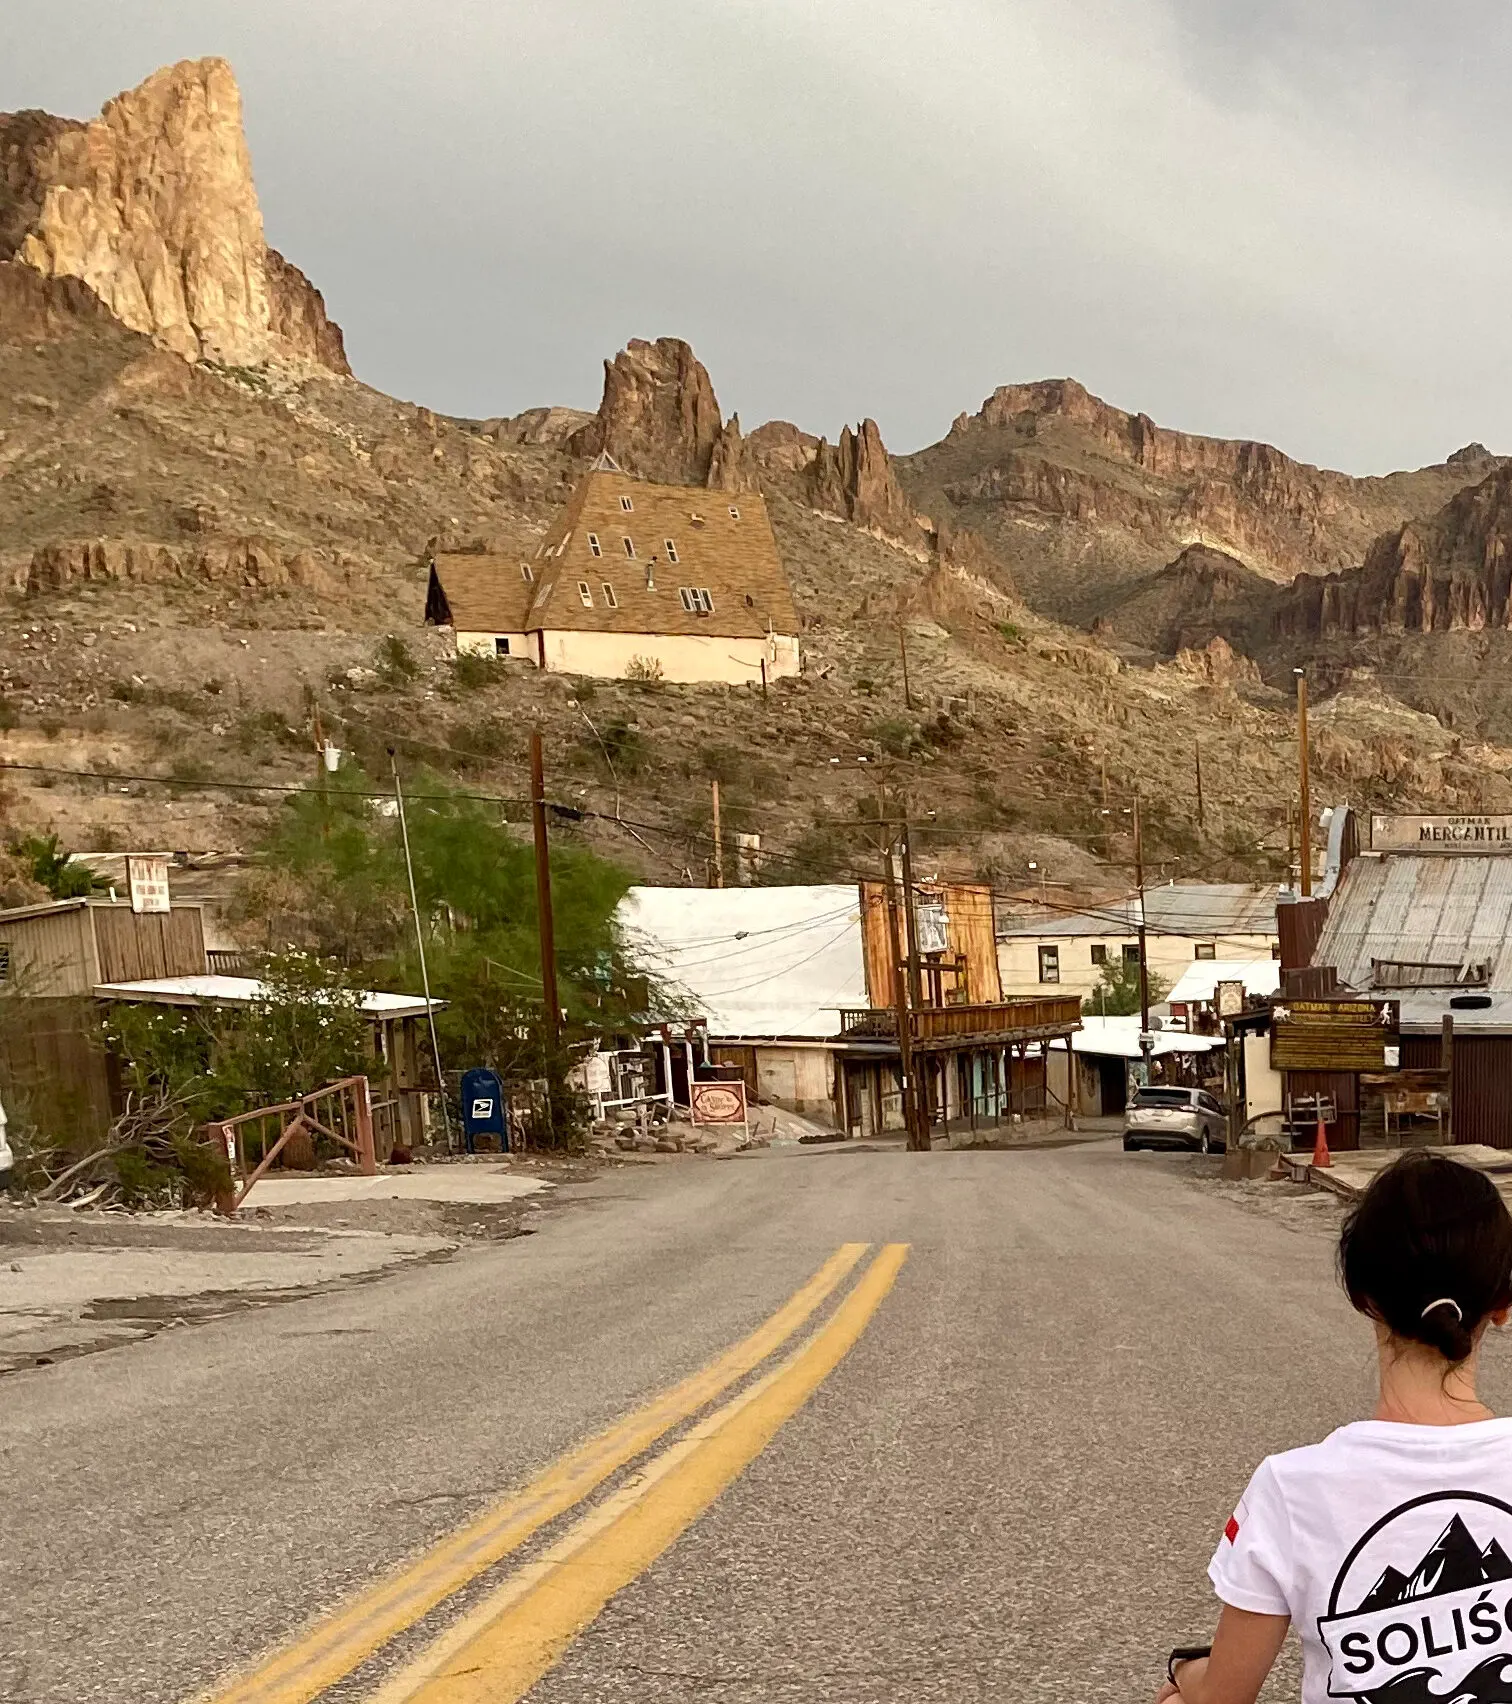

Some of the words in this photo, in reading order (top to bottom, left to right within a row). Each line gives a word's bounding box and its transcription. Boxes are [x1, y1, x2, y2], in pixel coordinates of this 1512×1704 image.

[1447, 817, 1491, 825] OATMAN
[1293, 1001, 1330, 1011] OATMAN
[1337, 1003, 1376, 1012] ARIZONA
